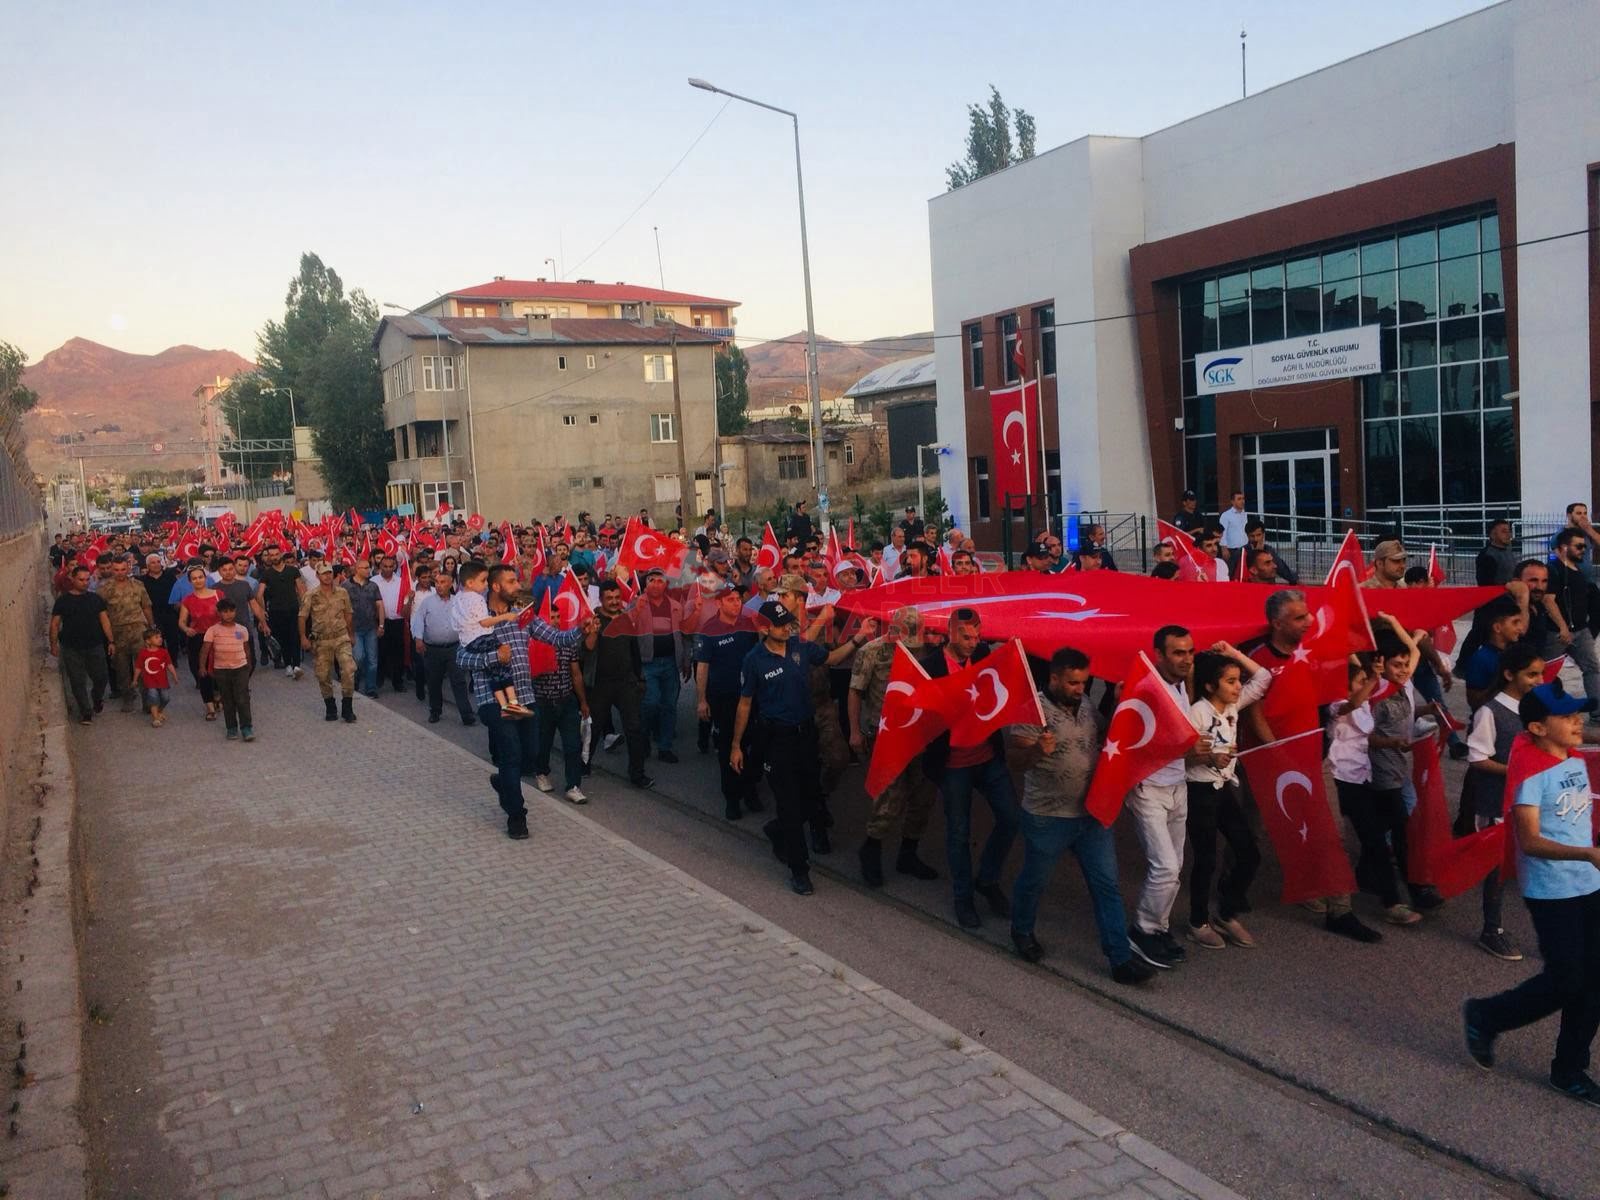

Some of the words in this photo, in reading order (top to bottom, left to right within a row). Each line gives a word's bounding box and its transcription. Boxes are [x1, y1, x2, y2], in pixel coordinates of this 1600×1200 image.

[1308, 339, 1320, 347] T.C.
[1271, 353, 1295, 363] SOSYAL
[1296, 346, 1329, 359] GÜVENLİK
[1330, 343, 1360, 354] KURUMU
[1208, 367, 1234, 384] SGK
[1296, 370, 1319, 380] SOSYAL
